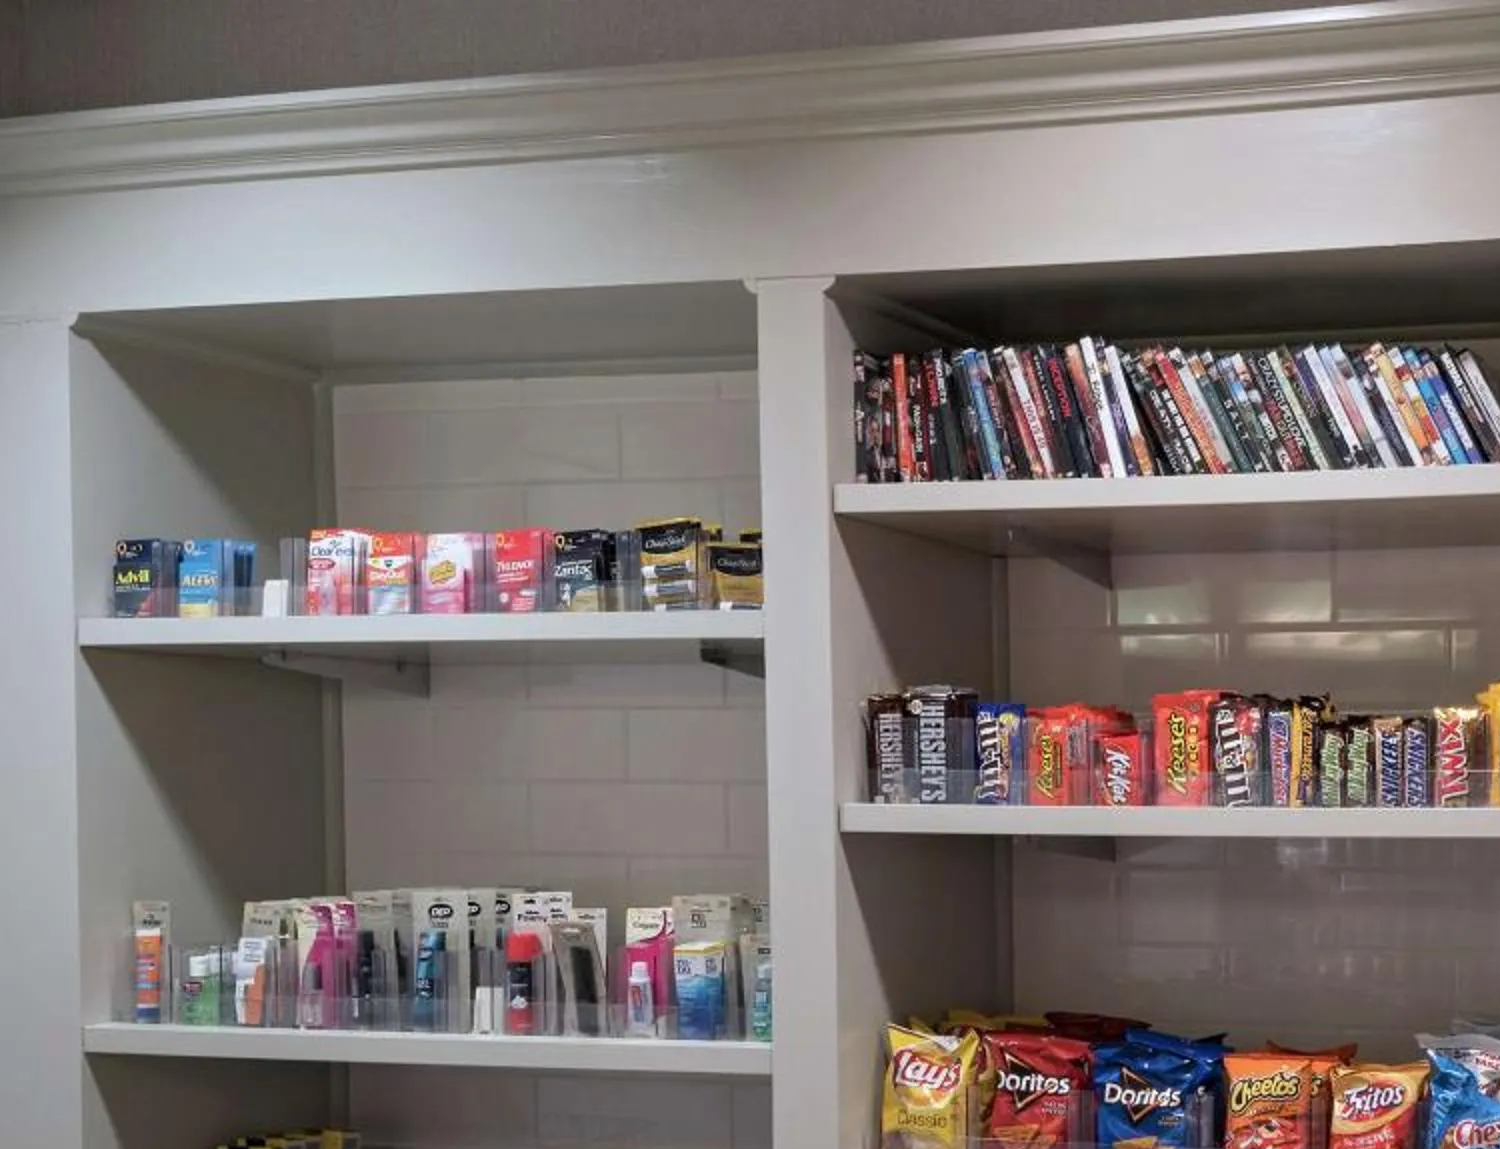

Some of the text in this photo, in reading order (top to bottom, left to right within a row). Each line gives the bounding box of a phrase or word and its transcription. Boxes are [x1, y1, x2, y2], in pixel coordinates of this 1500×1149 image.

[116, 568, 151, 585] Advil
[554, 565, 592, 578] Zantac
[1104, 1082, 1182, 1107] Doritos
[1231, 1074, 1300, 1113] Cheetos
[1343, 1085, 1405, 1116] Fritos
[898, 1110, 948, 1129] Classic
